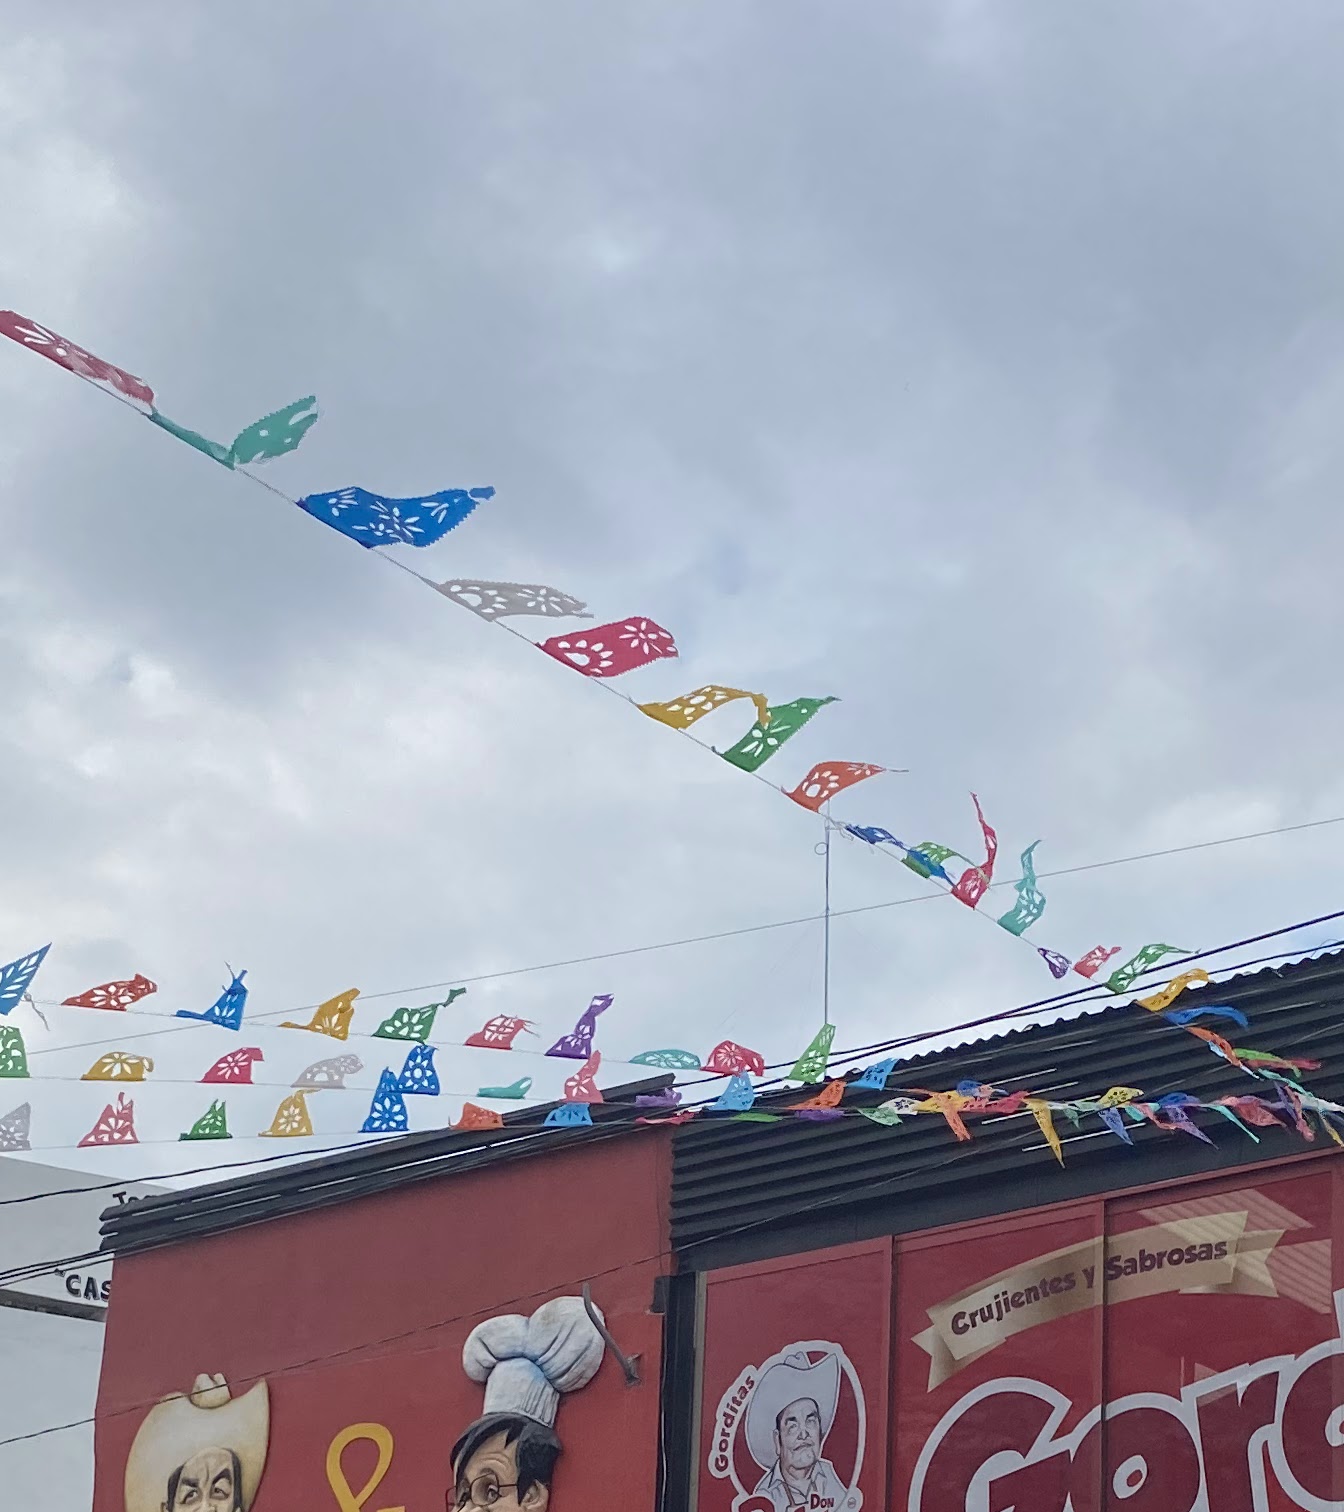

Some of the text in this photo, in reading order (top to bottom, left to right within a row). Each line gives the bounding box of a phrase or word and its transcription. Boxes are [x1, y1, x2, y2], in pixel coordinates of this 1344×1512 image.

[951, 1240, 1228, 1335] Crujientes y Sabrosas
[714, 1374, 755, 1474] Gorditas
